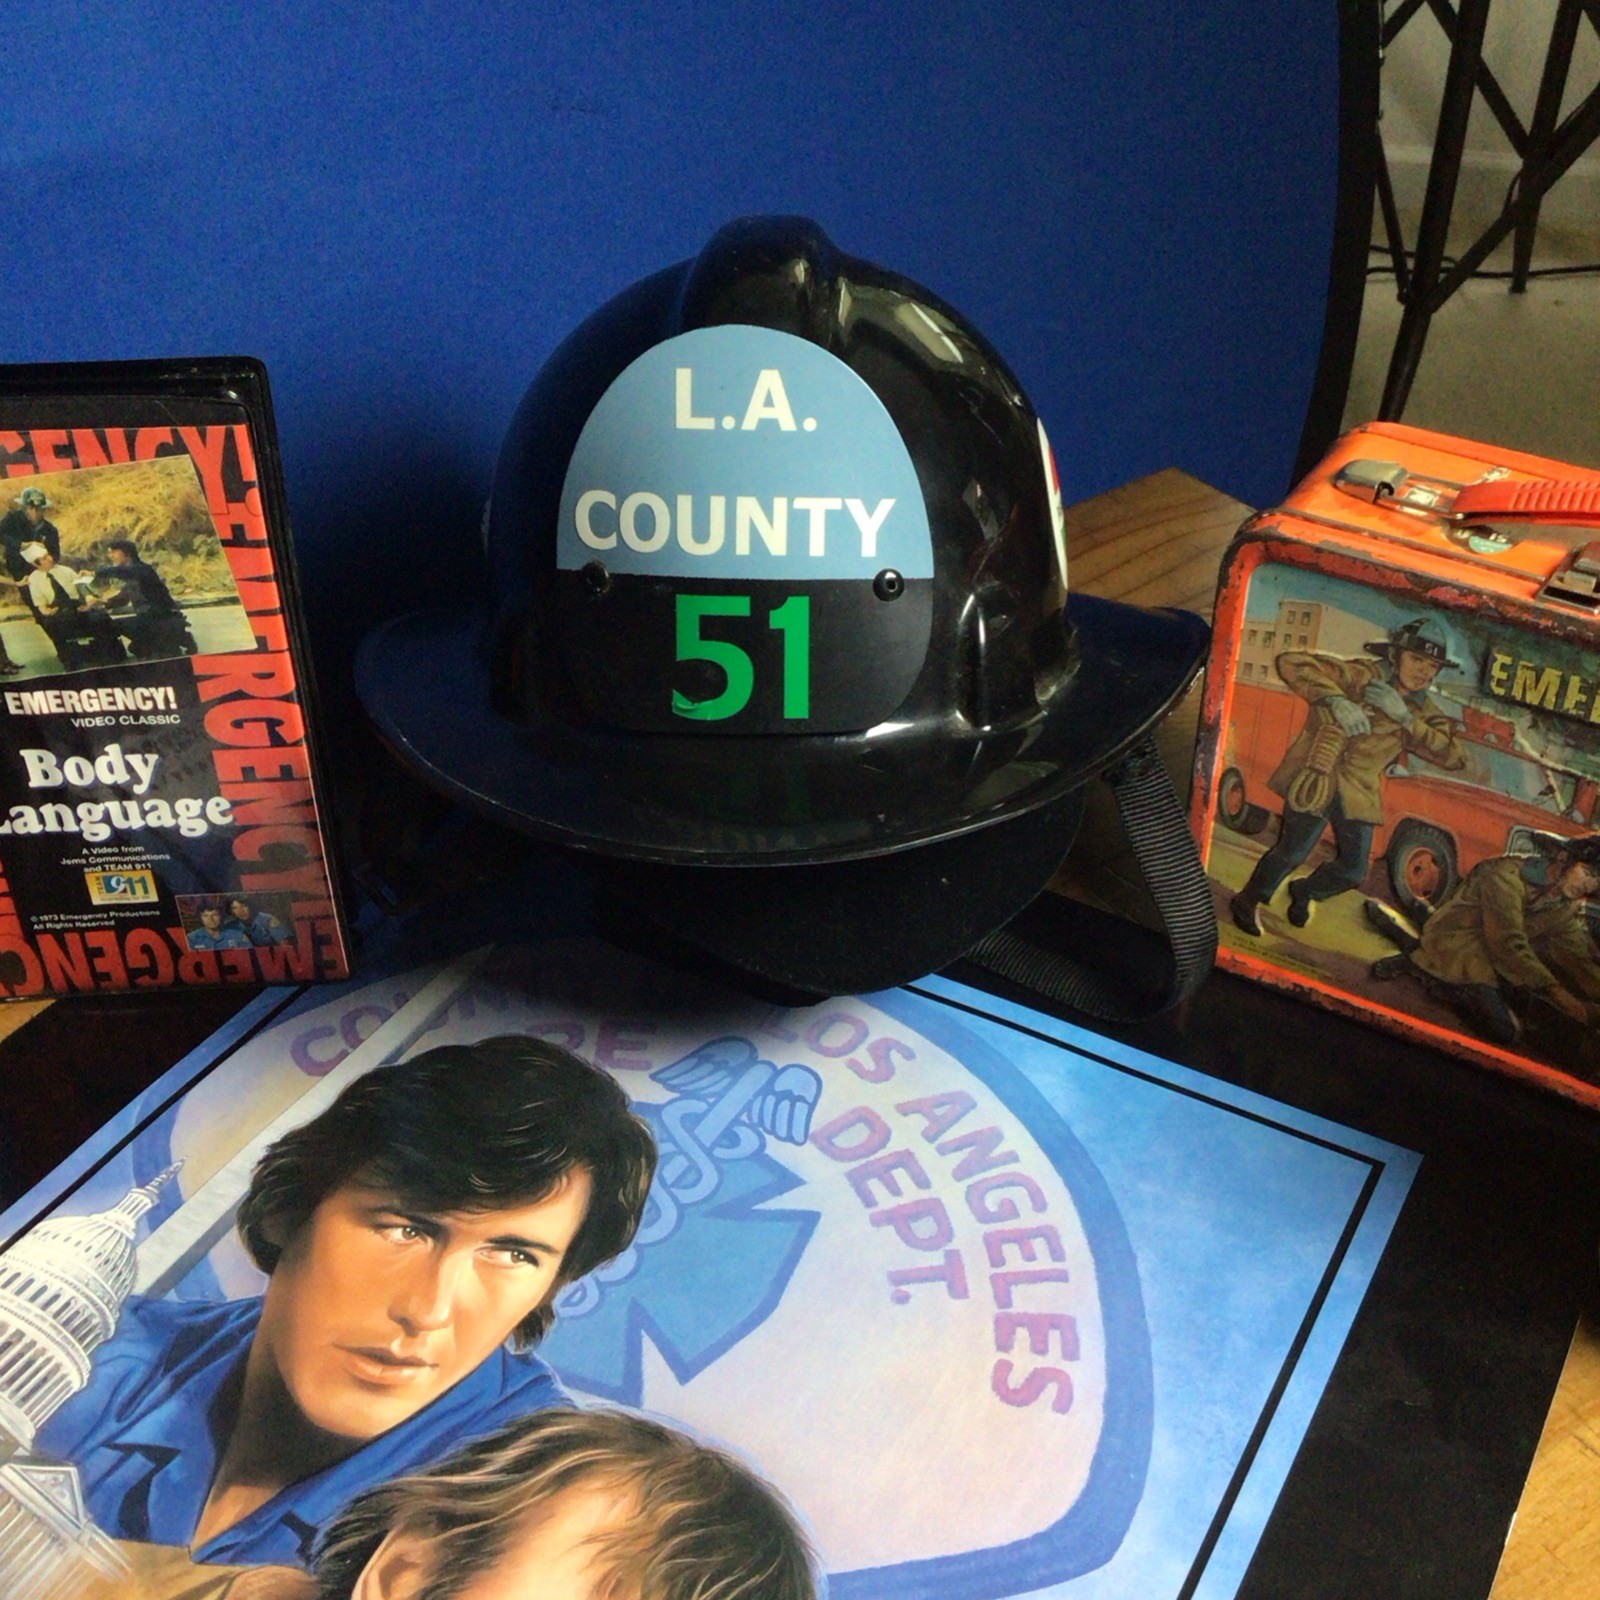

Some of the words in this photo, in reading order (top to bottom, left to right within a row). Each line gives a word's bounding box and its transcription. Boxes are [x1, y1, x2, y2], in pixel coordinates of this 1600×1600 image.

[675, 367, 818, 432] L.A.
[574, 489, 897, 558] COUNTY
[672, 593, 811, 721] 51
[1424, 642, 1438, 656] 51
[4, 686, 178, 716] EMERGENCY!
[71, 715, 116, 728] VIDEO
[119, 713, 181, 726] CLASSIC
[19, 743, 159, 795] Body
[83, 865, 102, 873] and
[103, 863, 133, 871] TEAM
[134, 862, 152, 870] 911
[88, 853, 170, 864] Communications
[110, 875, 149, 896] 911
[33, 923, 44, 931] All
[46, 921, 74, 930] Rights
[75, 919, 115, 928] Reserved
[60, 912, 107, 922] Emergency
[109, 910, 160, 919] Productions
[760, 1006, 916, 1084] LOS
[893, 1090, 1081, 1416] ANGELES
[809, 1104, 970, 1306] DEPT.
